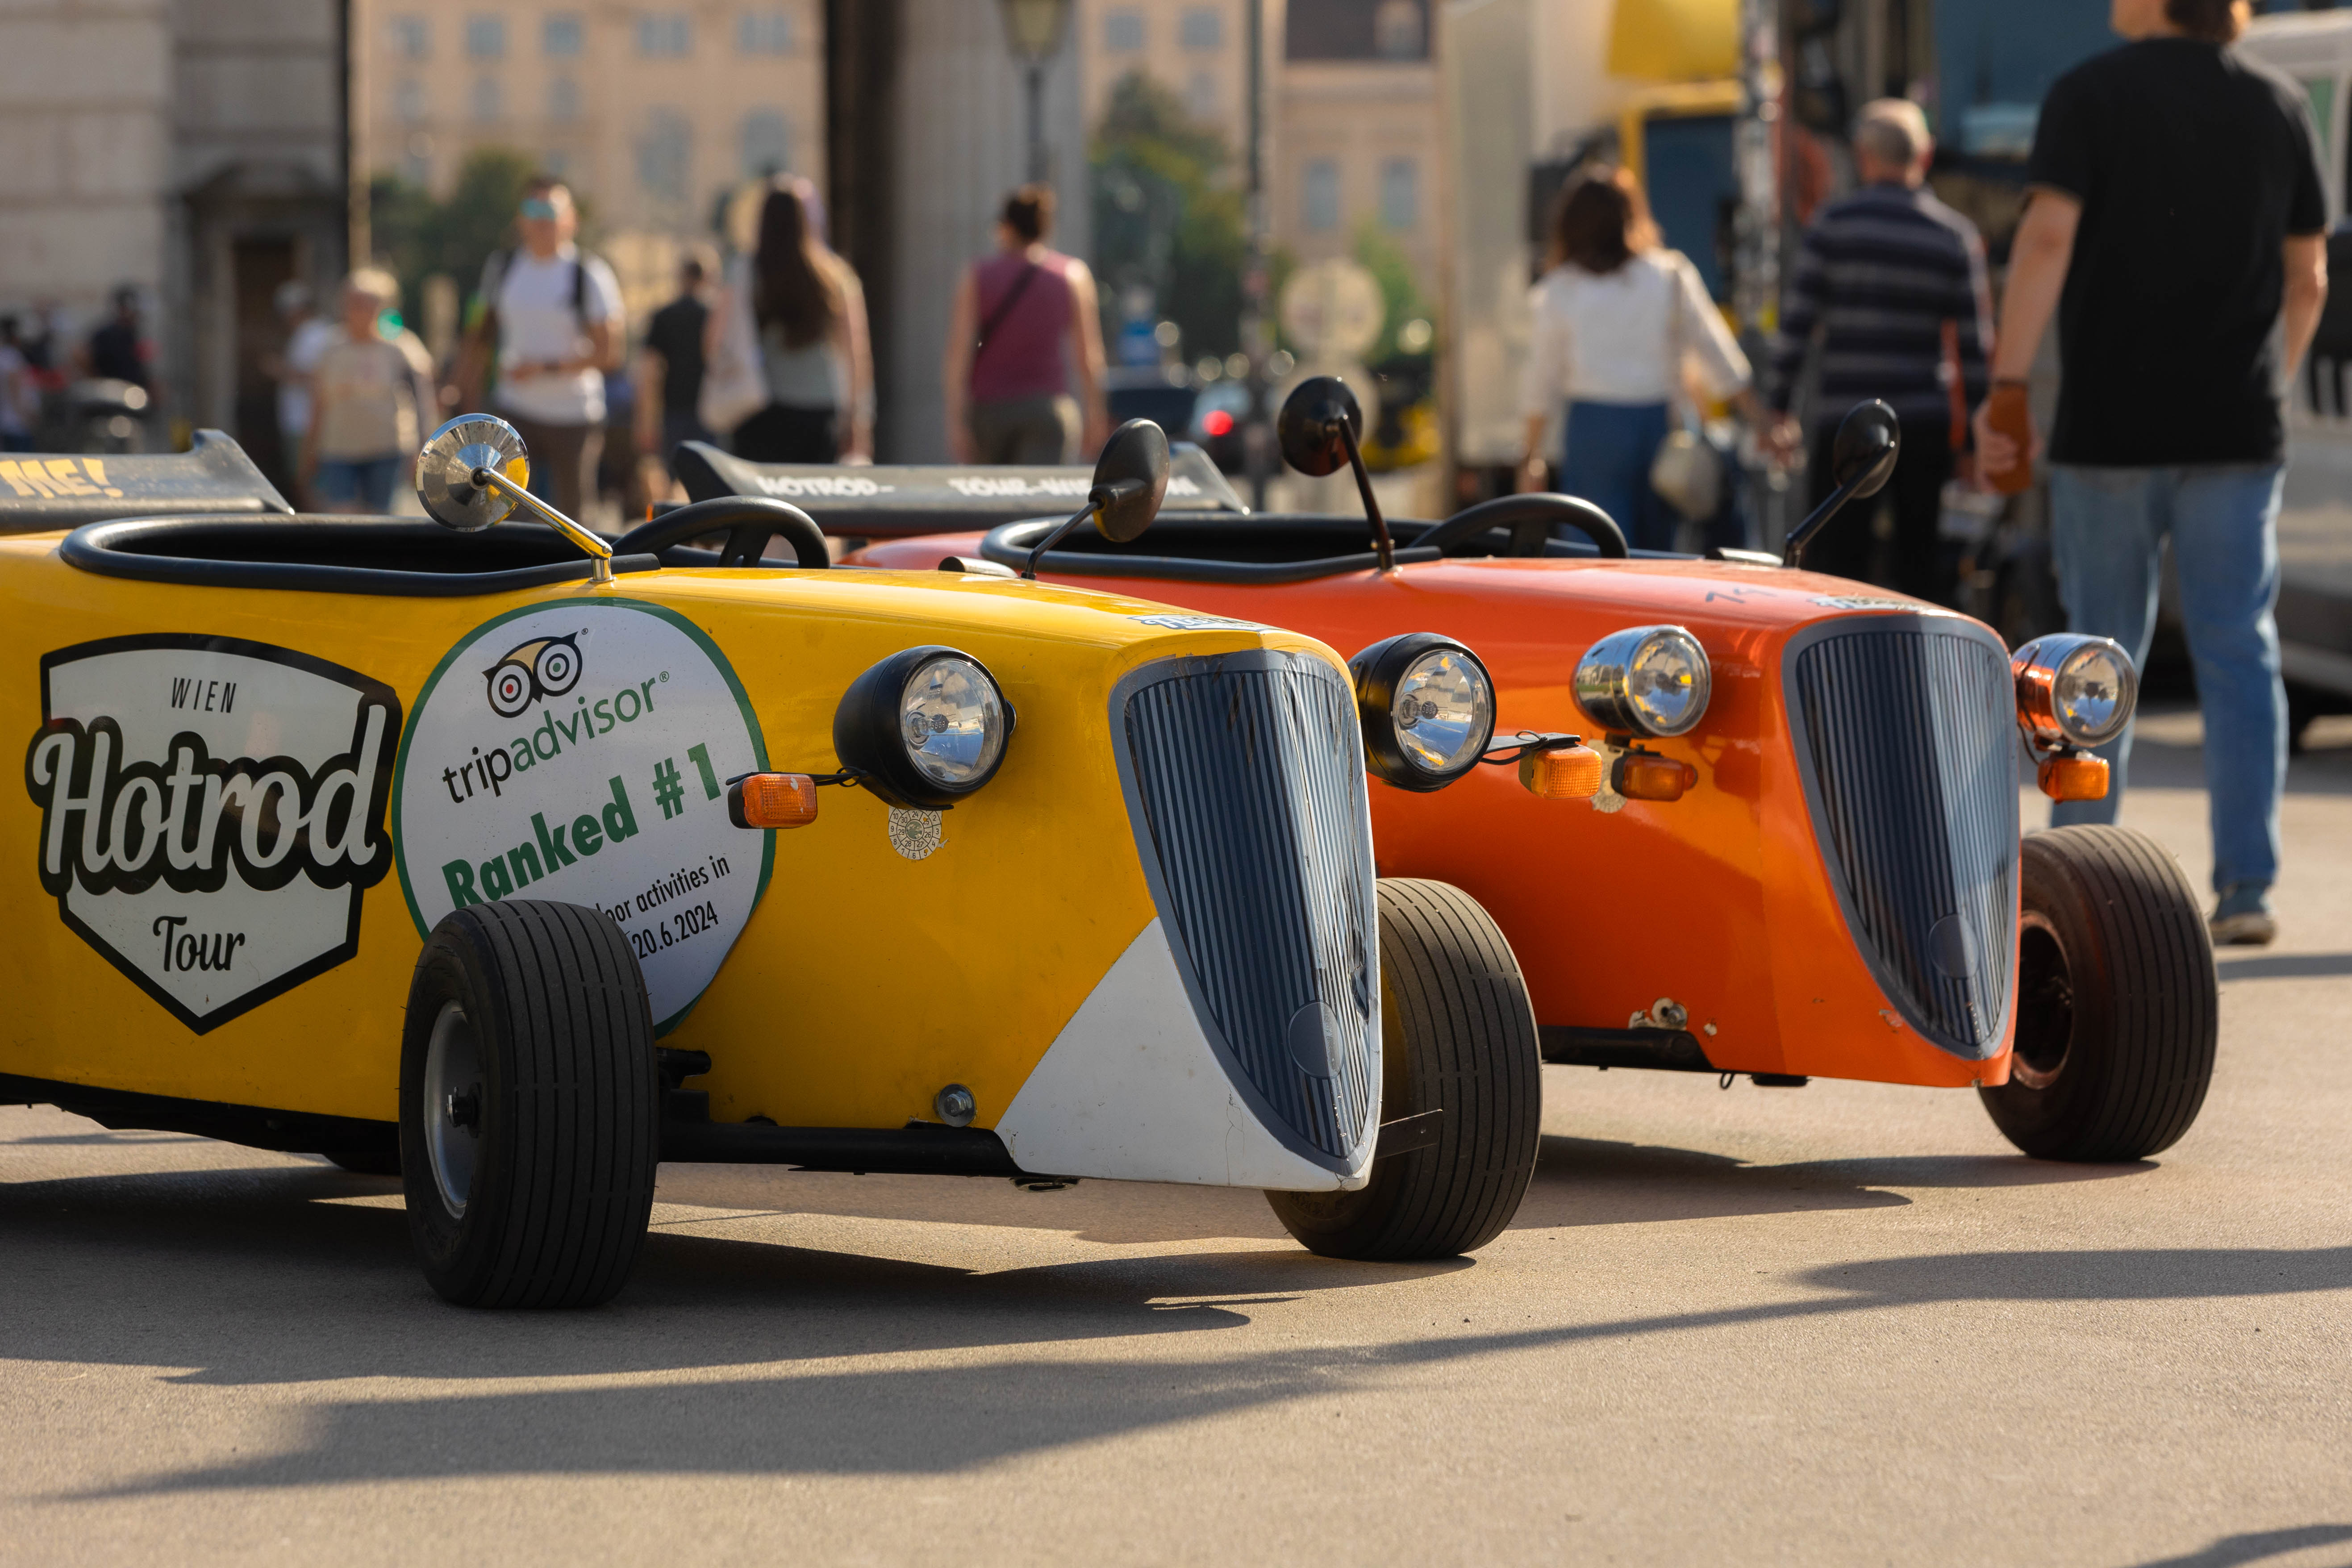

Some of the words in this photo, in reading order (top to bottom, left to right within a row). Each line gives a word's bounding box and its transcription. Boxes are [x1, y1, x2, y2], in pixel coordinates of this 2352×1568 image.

[0, 458, 123, 499] ME!
[171, 677, 237, 713] WIEN
[33, 705, 387, 875] Hotrod
[442, 775, 639, 909] Ranked
[596, 900, 632, 922] oor
[636, 868, 709, 912] activities
[709, 855, 730, 879] in
[153, 916, 245, 972] Tour
[632, 901, 718, 959] 20.6.2024
